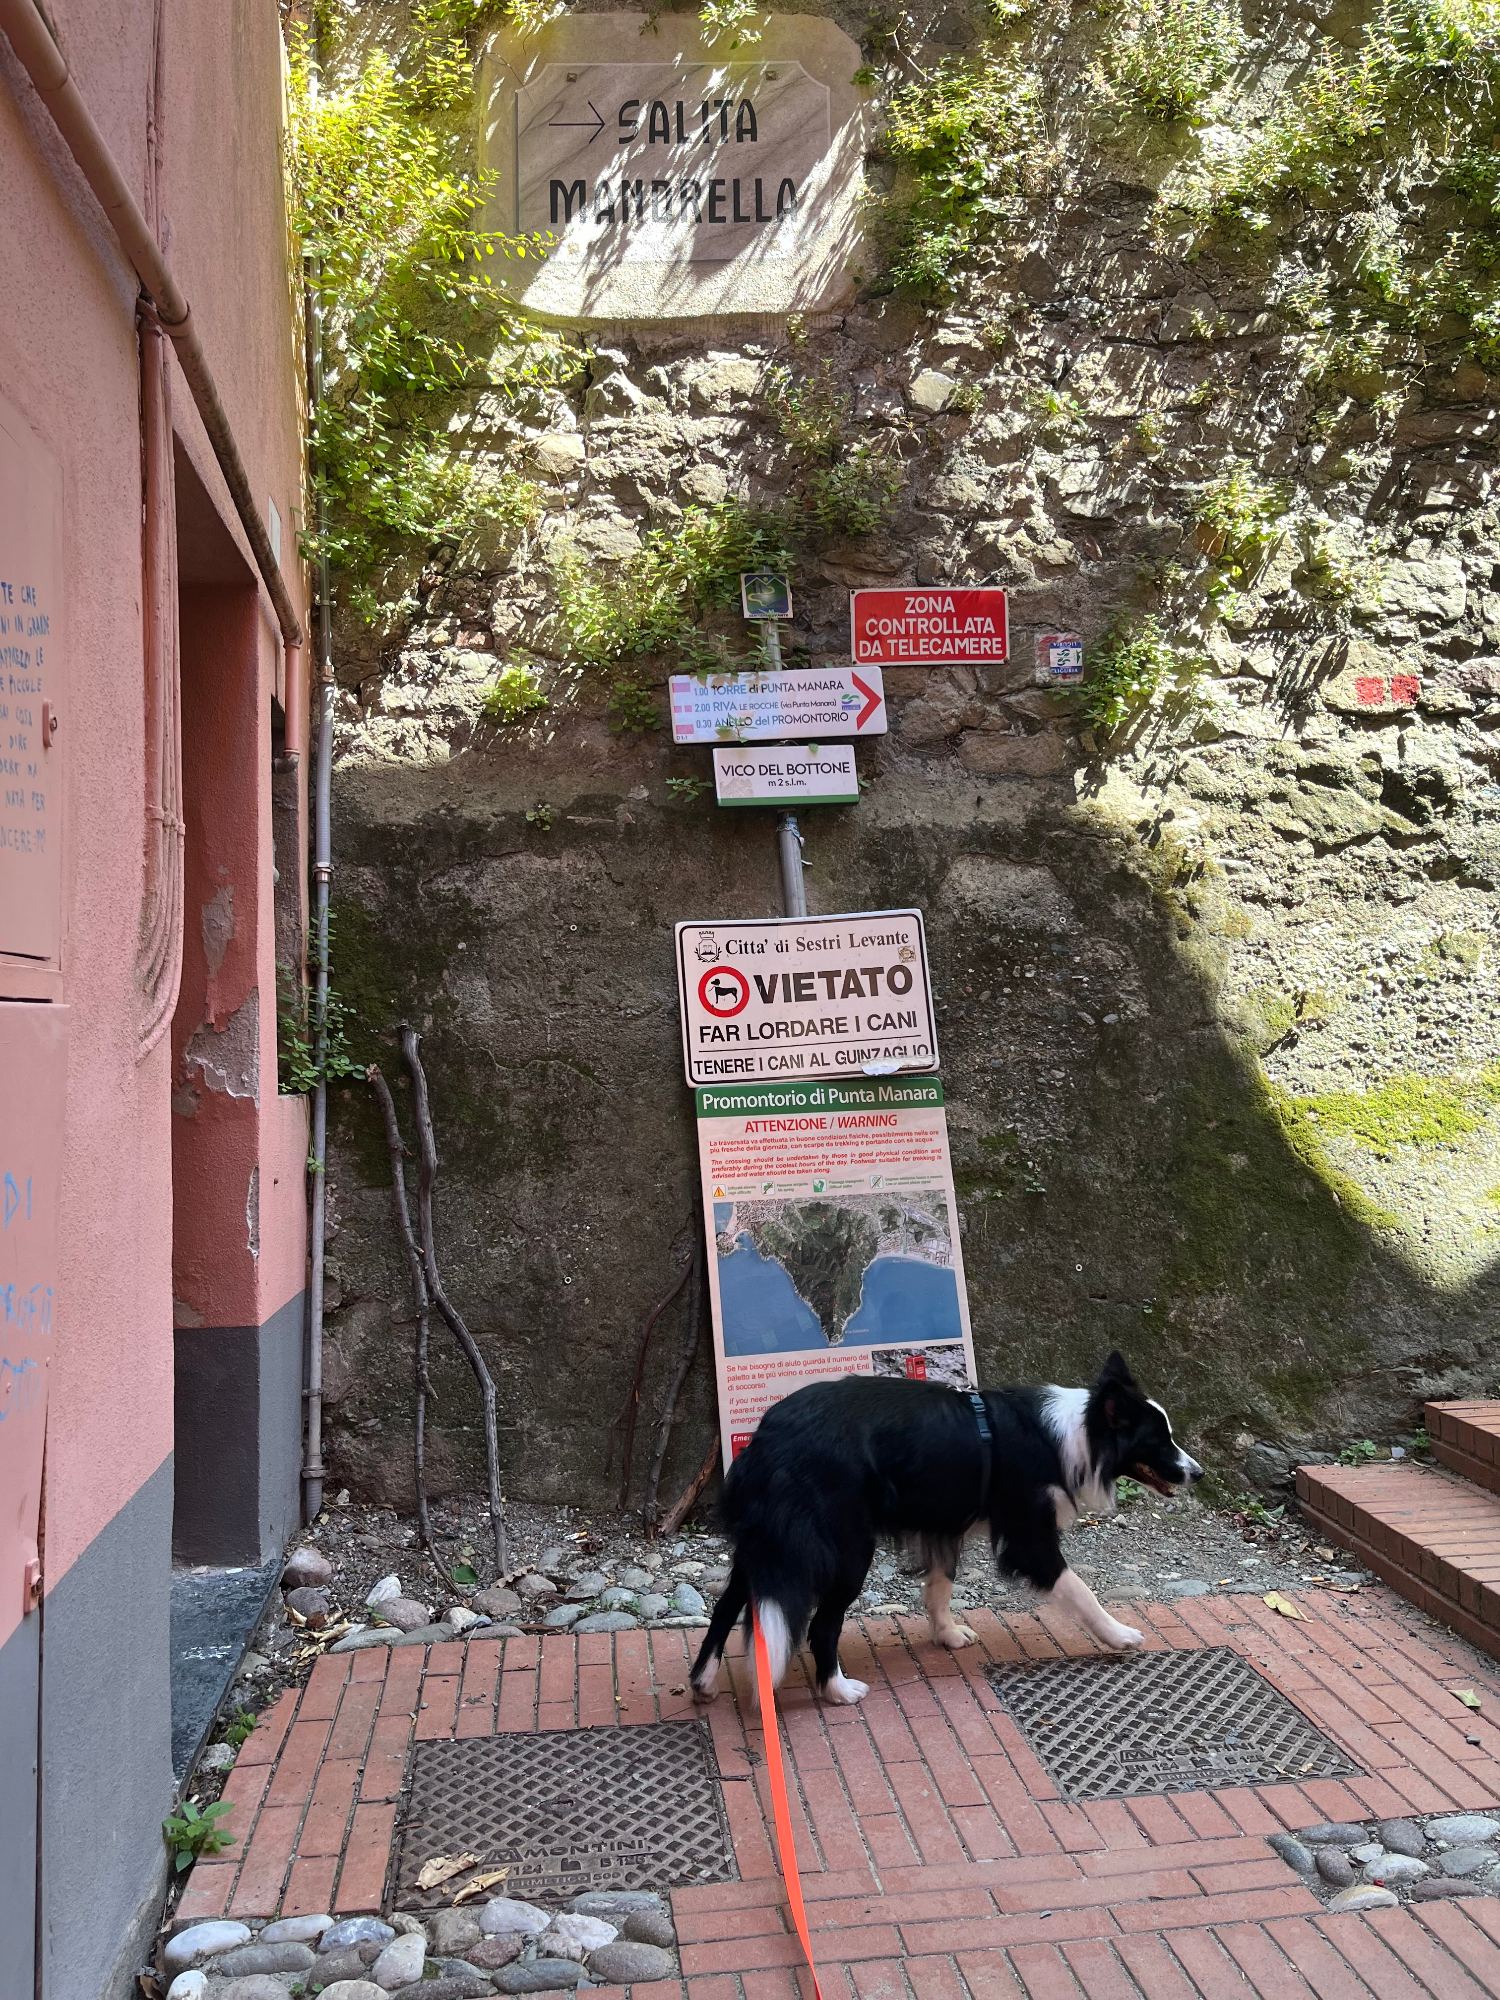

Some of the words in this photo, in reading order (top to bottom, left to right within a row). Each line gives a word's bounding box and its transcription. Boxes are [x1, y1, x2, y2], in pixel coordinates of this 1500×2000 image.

[618, 100, 758, 144] SALITA
[550, 177, 798, 224] MANDRELLA
[904, 597, 955, 614] ZONA
[865, 617, 995, 636] CONTROLLATA
[859, 640, 883, 657] DA
[887, 638, 1002, 656] TELECAMERE
[711, 684, 746, 695] TORRE
[749, 685, 758, 693] di
[761, 683, 796, 693] PUNTA
[798, 680, 844, 692] MANARA
[695, 703, 710, 712] 2.00
[713, 702, 737, 712] RIVA
[749, 702, 778, 710] ROCCHE
[780, 700, 791, 709] (via
[810, 699, 837, 707] Manara)
[696, 719, 712, 728] 0.30
[715, 717, 752, 728] ANLO
[755, 716, 770, 726] del
[772, 712, 848, 725] PROMONTORIO
[721, 765, 755, 776] VICO
[759, 764, 784, 776] DEL
[786, 762, 850, 775] BOTTONE
[785, 778, 807, 786] s.l.m.
[725, 939, 768, 955] Citta'
[775, 939, 789, 953] di
[796, 934, 841, 952] Sestri
[848, 931, 909, 948] Levante
[753, 964, 913, 1004] VIETATO
[699, 1025, 740, 1043] FAR
[747, 1017, 848, 1040] LORDARE
[855, 1015, 860, 1032] I
[867, 1011, 918, 1031] CANI
[694, 1058, 754, 1075] TENERE
[759, 1056, 763, 1071] I
[768, 1054, 804, 1071] CANI
[810, 1052, 829, 1068] AL
[702, 1090, 806, 1110] Promontorio
[810, 1088, 825, 1105] di
[829, 1087, 875, 1104] Punta
[878, 1086, 938, 1102] Manara
[745, 1117, 826, 1133] ATTENZIONE
[830, 1117, 834, 1130] /
[838, 1114, 898, 1129] WARNING
[872, 1131, 913, 1139] possibilmente
[762, 1144, 790, 1152] giornata,
[711, 1165, 742, 1173] preferably
[802, 1358, 825, 1366] guarda
[832, 1355, 857, 1363] numero
[727, 1374, 750, 1383] paletto
[766, 1372, 776, 1380] più
[805, 1366, 842, 1375] comunicalo
[844, 1364, 855, 1373] agli
[856, 1363, 870, 1371] Enti
[736, 1397, 748, 1406] you
[751, 1395, 768, 1403] need
[730, 1406, 755, 1414] nearest
[1153, 1743, 1255, 1758] MONTINI
[1125, 1764, 1149, 1773] EN
[1152, 1762, 1180, 1771] 124
[524, 1839, 644, 1858] MONTINI
[514, 1864, 544, 1876] 124
[600, 1858, 611, 1868] B
